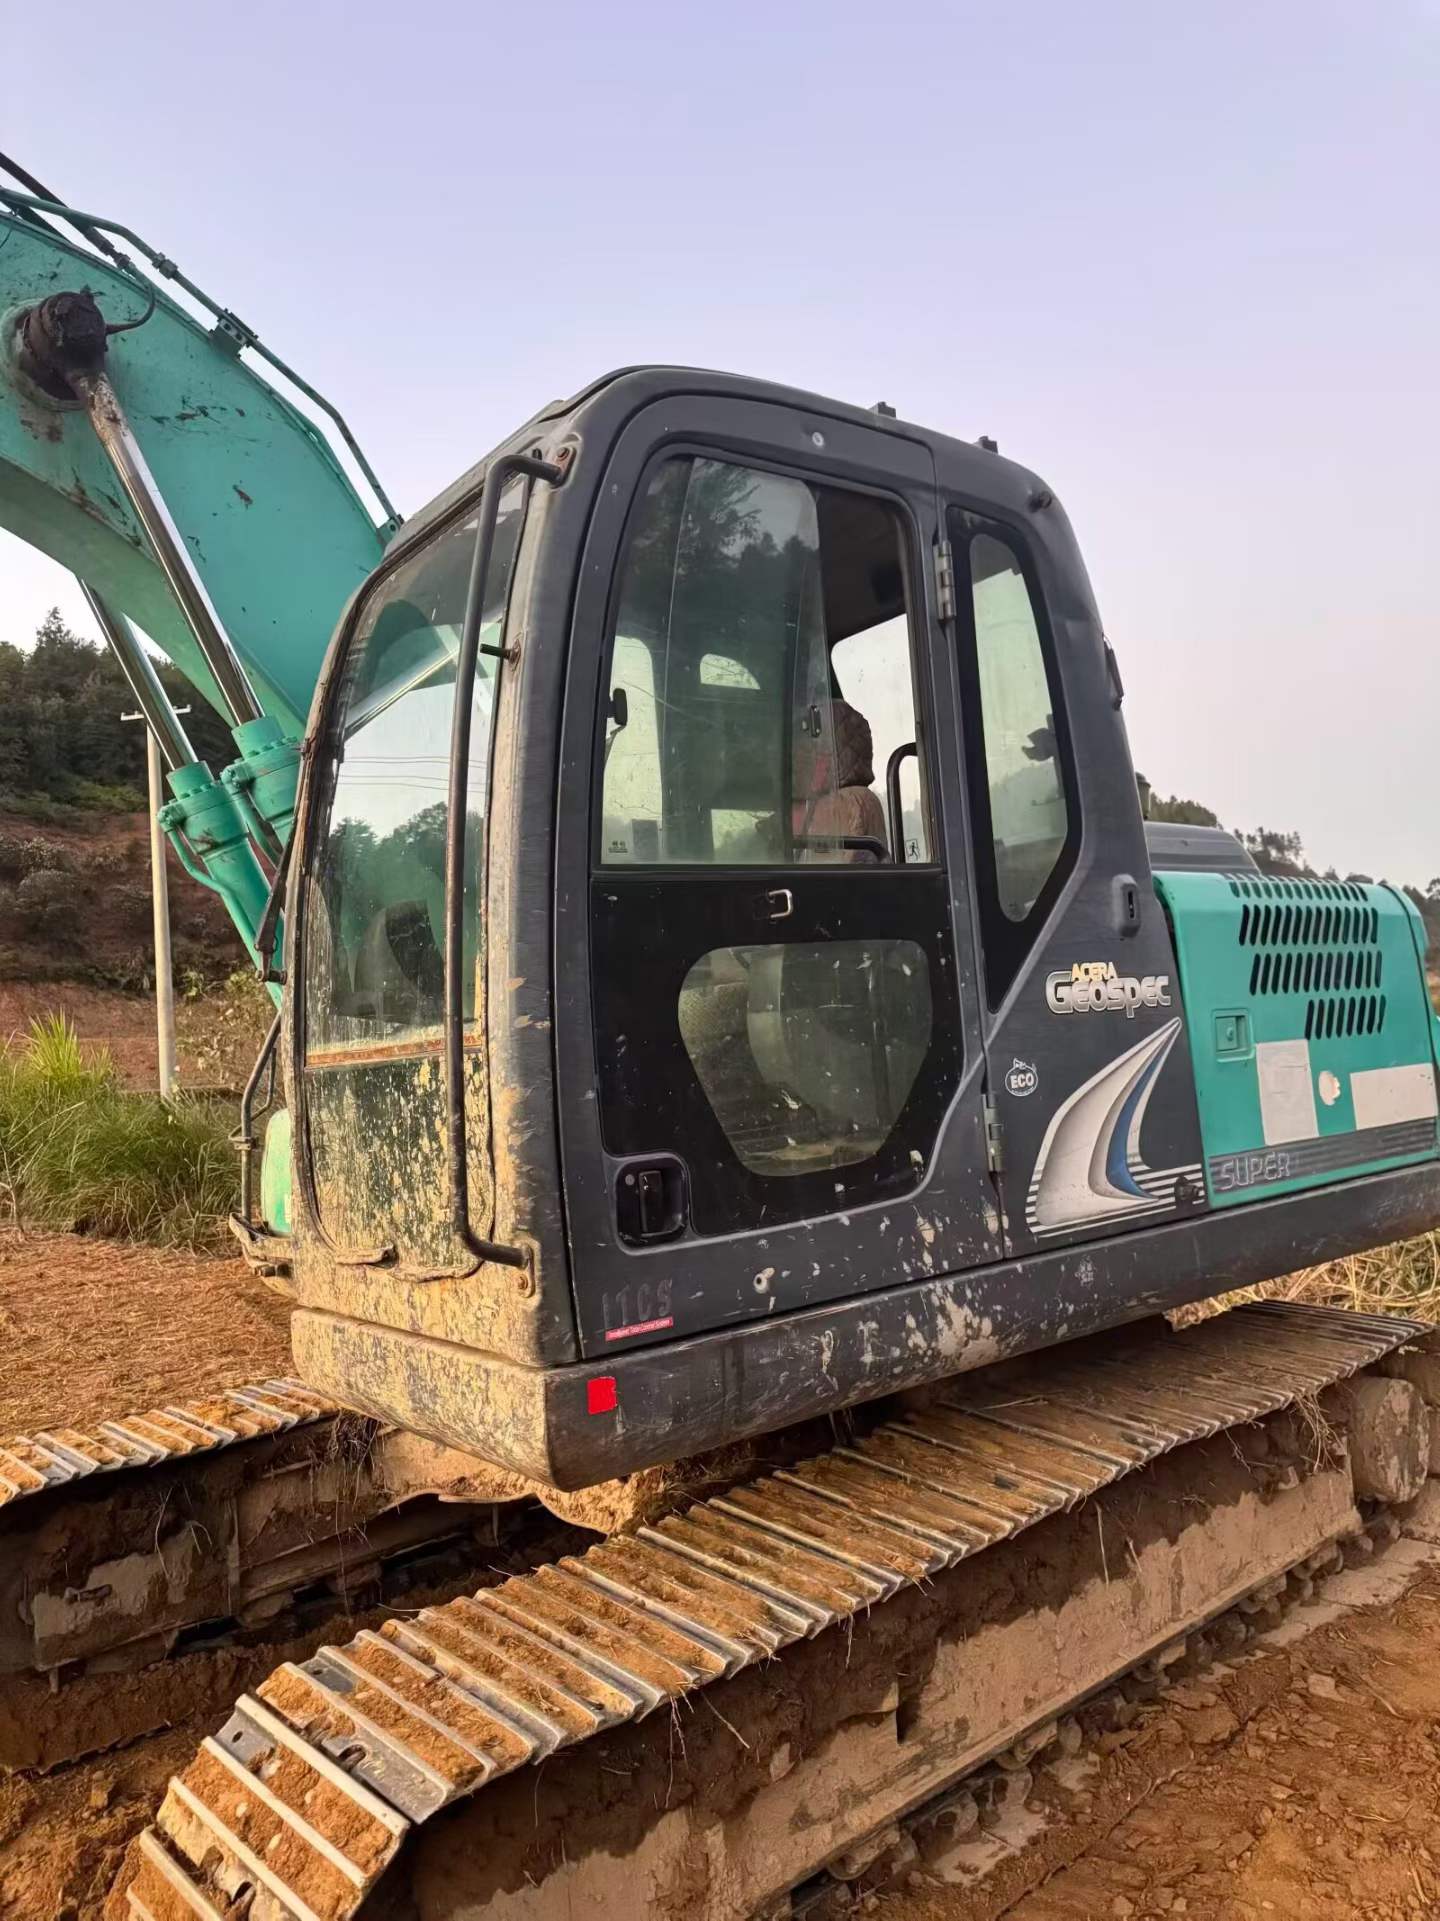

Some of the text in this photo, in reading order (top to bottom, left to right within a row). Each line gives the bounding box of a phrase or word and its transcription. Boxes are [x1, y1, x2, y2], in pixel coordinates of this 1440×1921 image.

[1071, 962, 1118, 982] ACERA
[1010, 1072, 1034, 1088] ECO
[1219, 1151, 1290, 1190] SUPER
